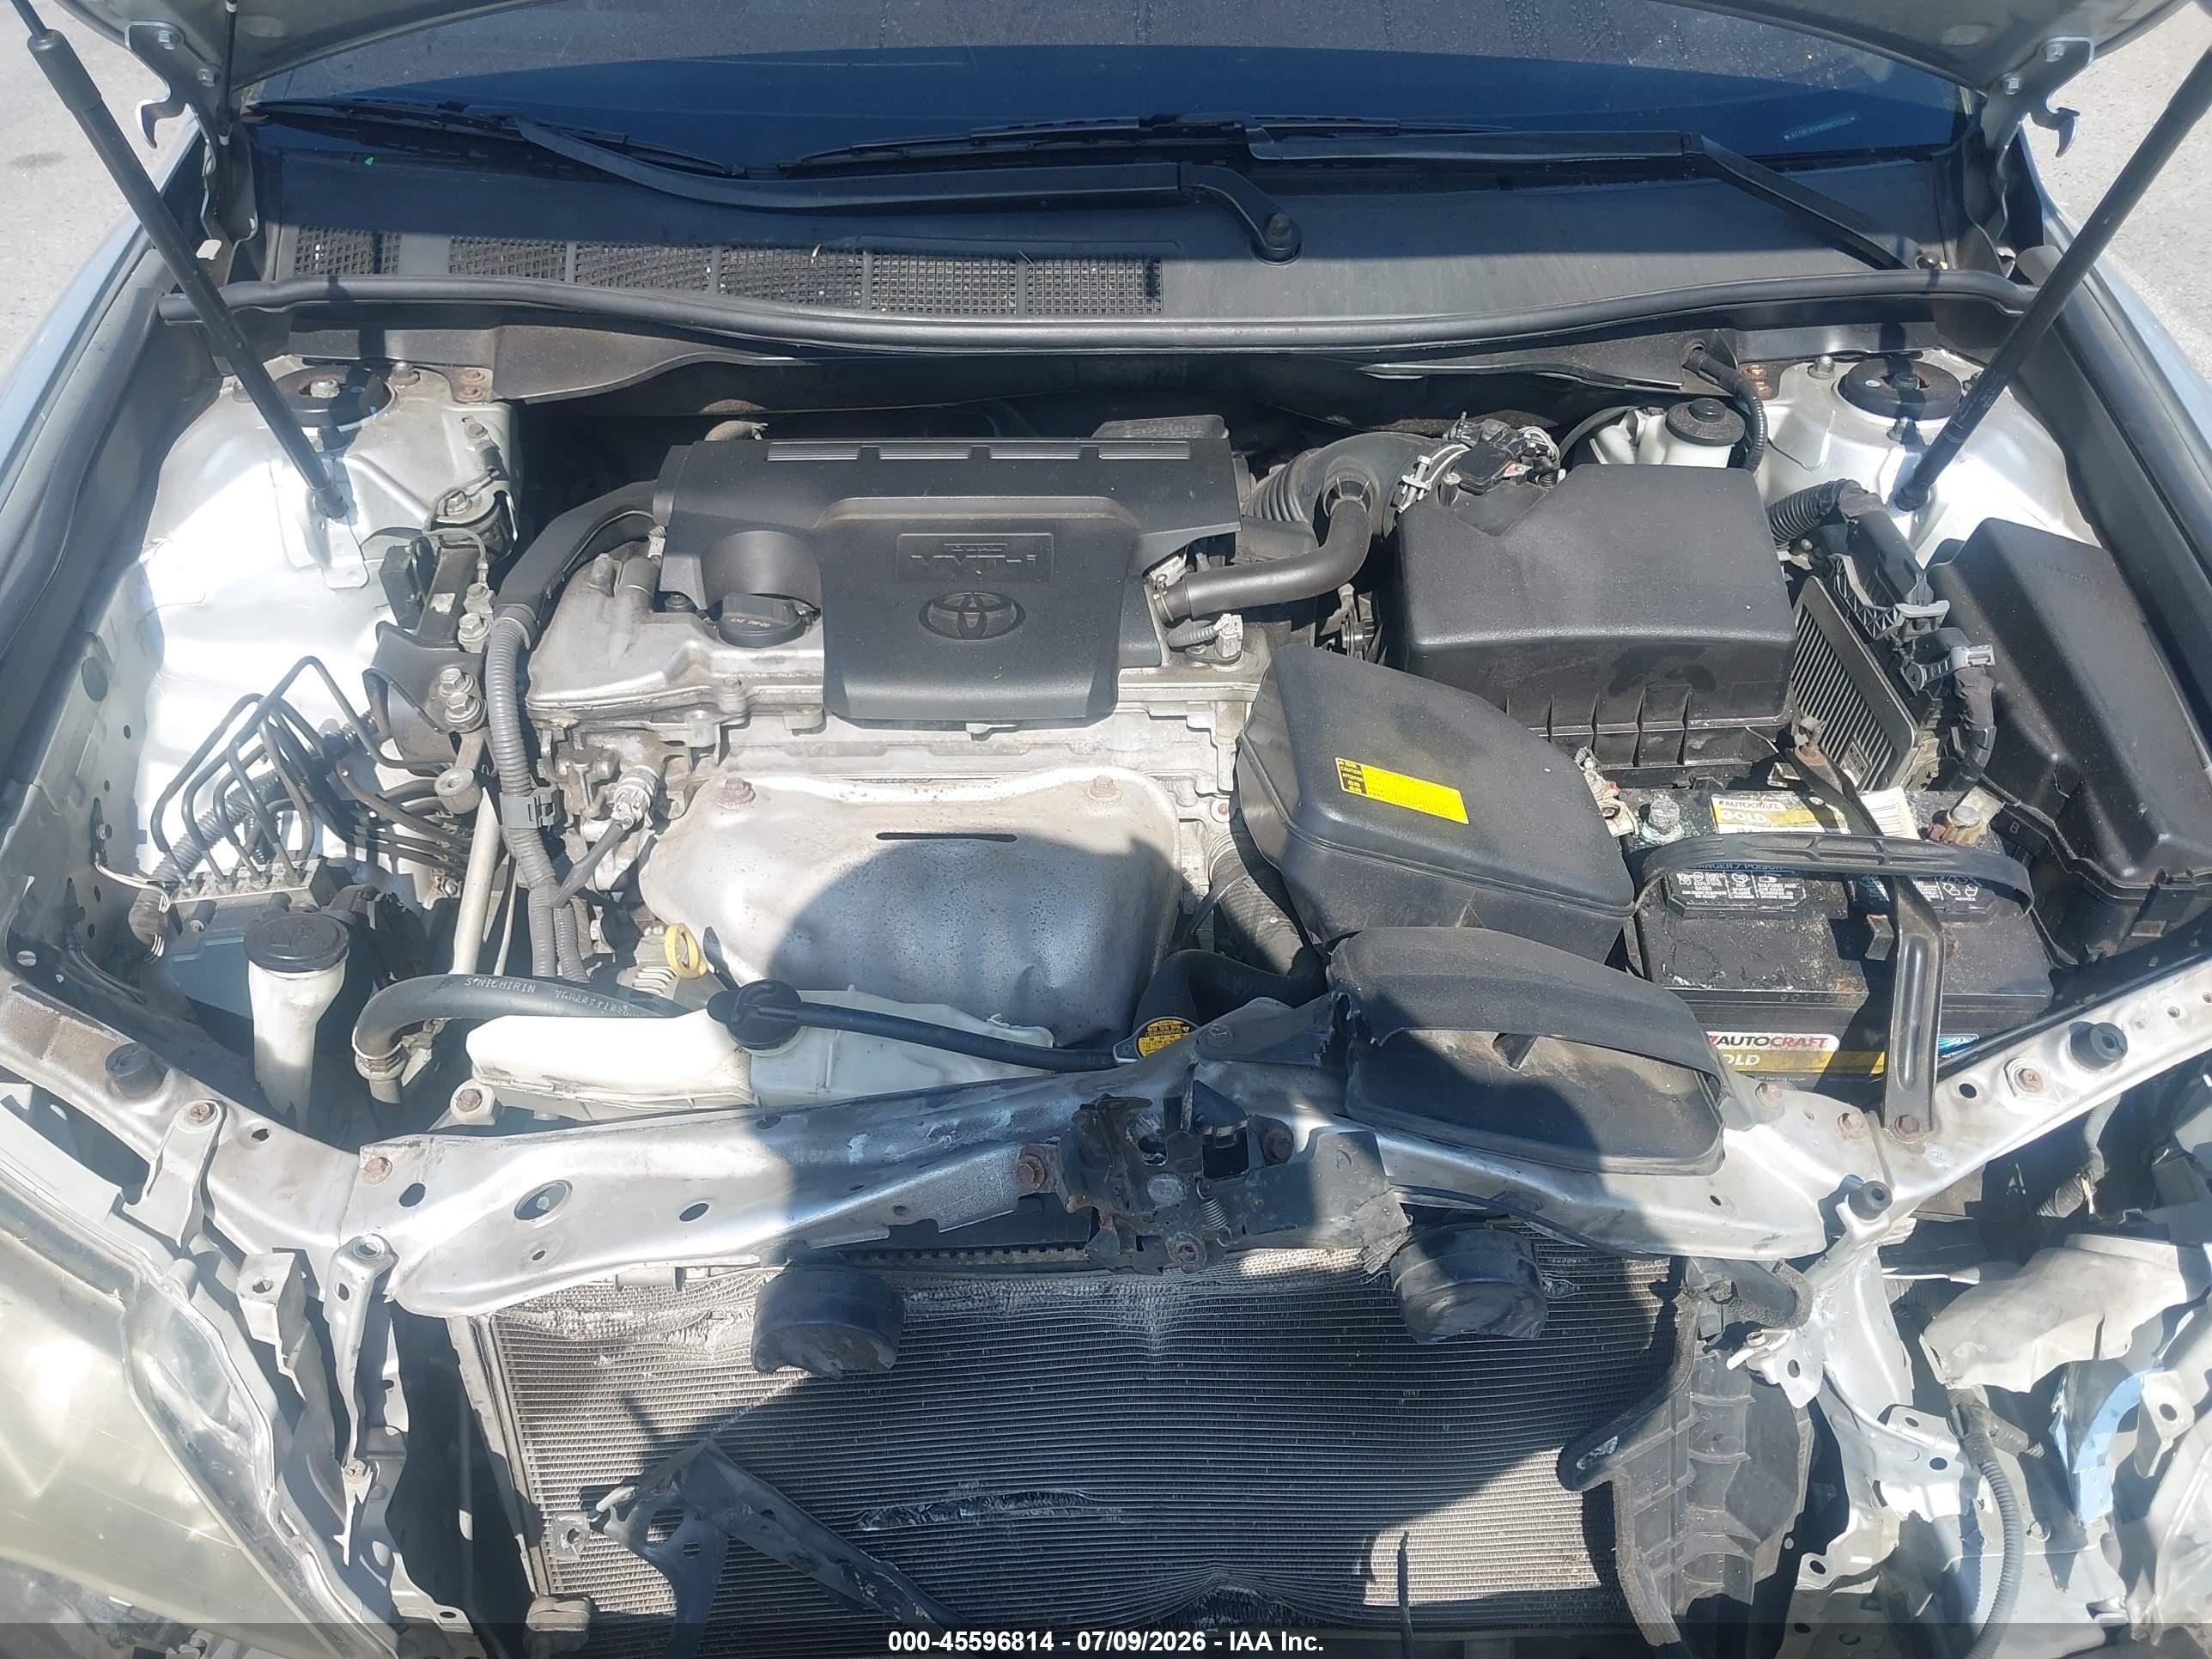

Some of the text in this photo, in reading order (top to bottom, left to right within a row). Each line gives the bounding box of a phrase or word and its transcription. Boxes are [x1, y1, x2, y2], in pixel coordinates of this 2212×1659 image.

[1721, 810, 1766, 823] GOLD
[2009, 821, 2021, 834] B
[1717, 1034, 1829, 1048] AUTOCRAFT
